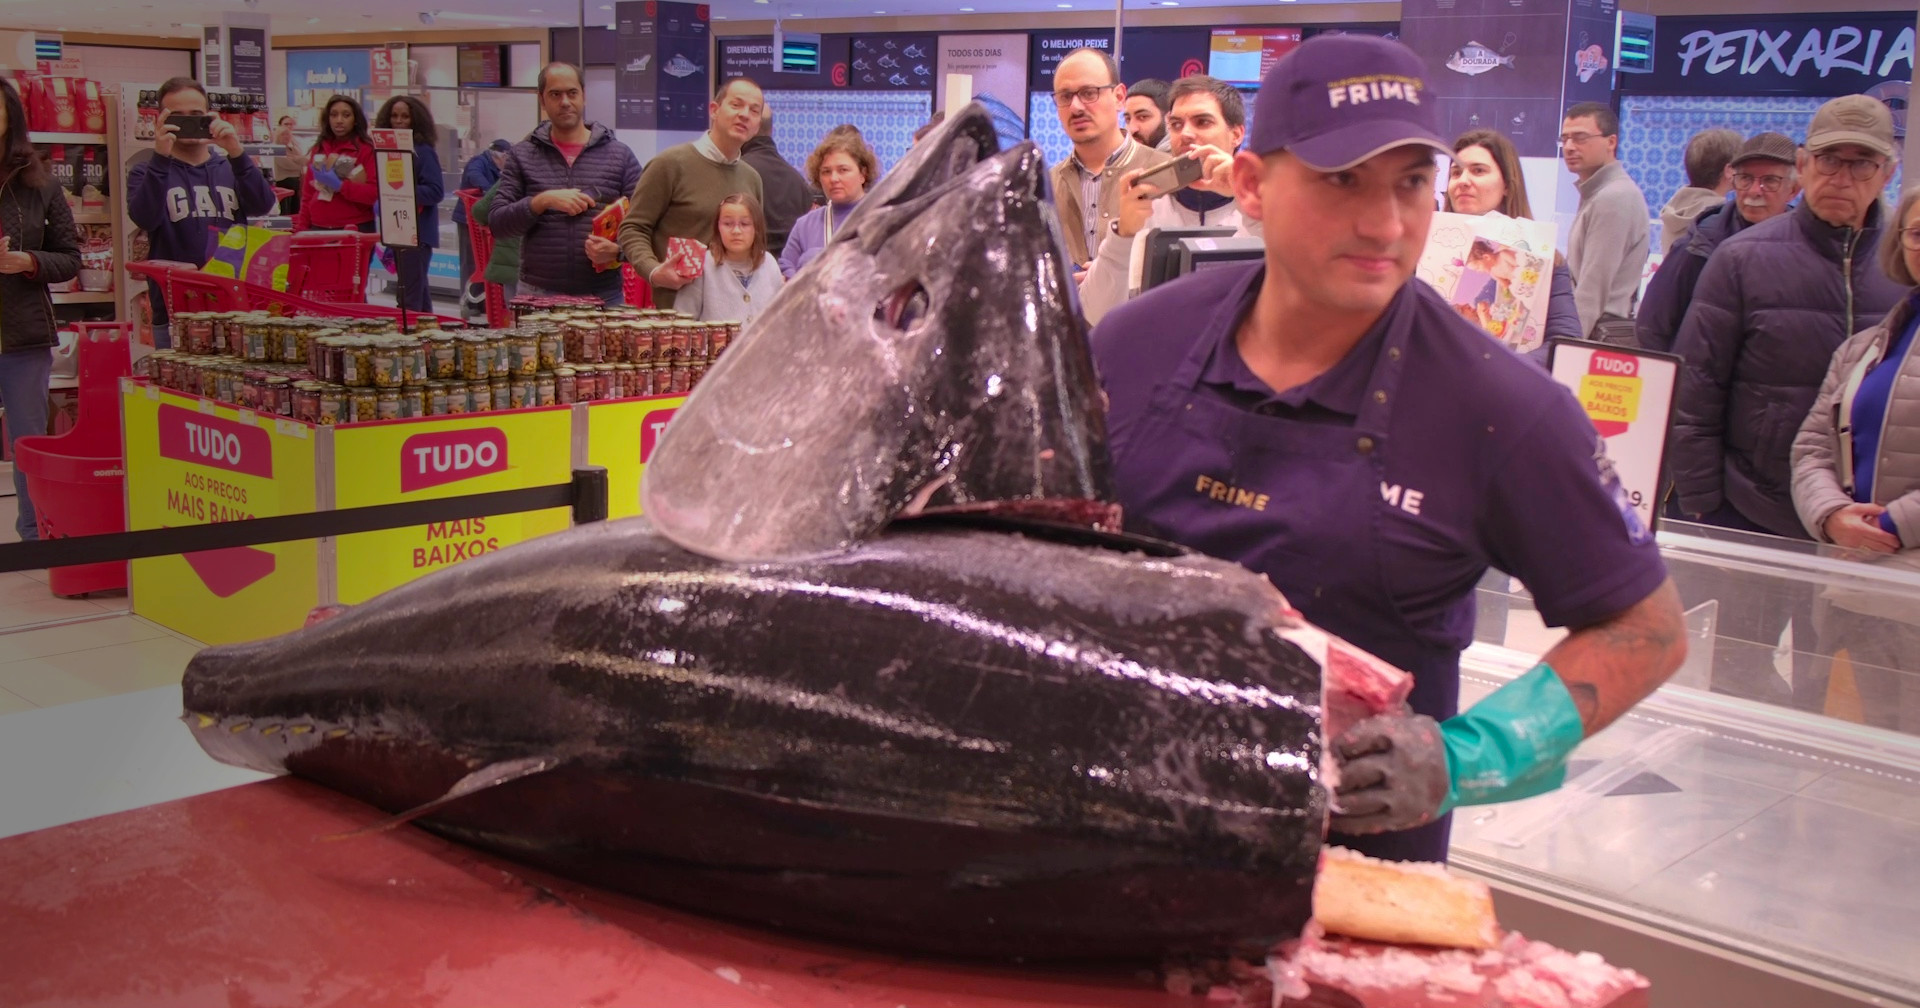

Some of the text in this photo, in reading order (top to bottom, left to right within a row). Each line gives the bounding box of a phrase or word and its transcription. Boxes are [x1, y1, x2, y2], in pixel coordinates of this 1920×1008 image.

[726, 46, 767, 54] DIRETAMENTE
[947, 48, 1002, 57] TODOS OS DIAS
[1042, 39, 1108, 48] O MELHOR PEIXE
[1677, 26, 1915, 77] PEIXARIA
[1328, 81, 1420, 108] FRIME
[167, 185, 240, 222] GAP
[1595, 356, 1635, 374] TUDO
[1586, 401, 1628, 417] BAIXOS
[1595, 391, 1622, 404] MAIS
[185, 422, 241, 465] TUDO
[413, 441, 498, 474] TUDO
[185, 471, 247, 505] AOS PREÇOS
[1195, 474, 1270, 511] FRIME
[168, 488, 205, 522] MAIS
[426, 516, 486, 541] MAIS
[413, 537, 499, 568] BAIXOS
